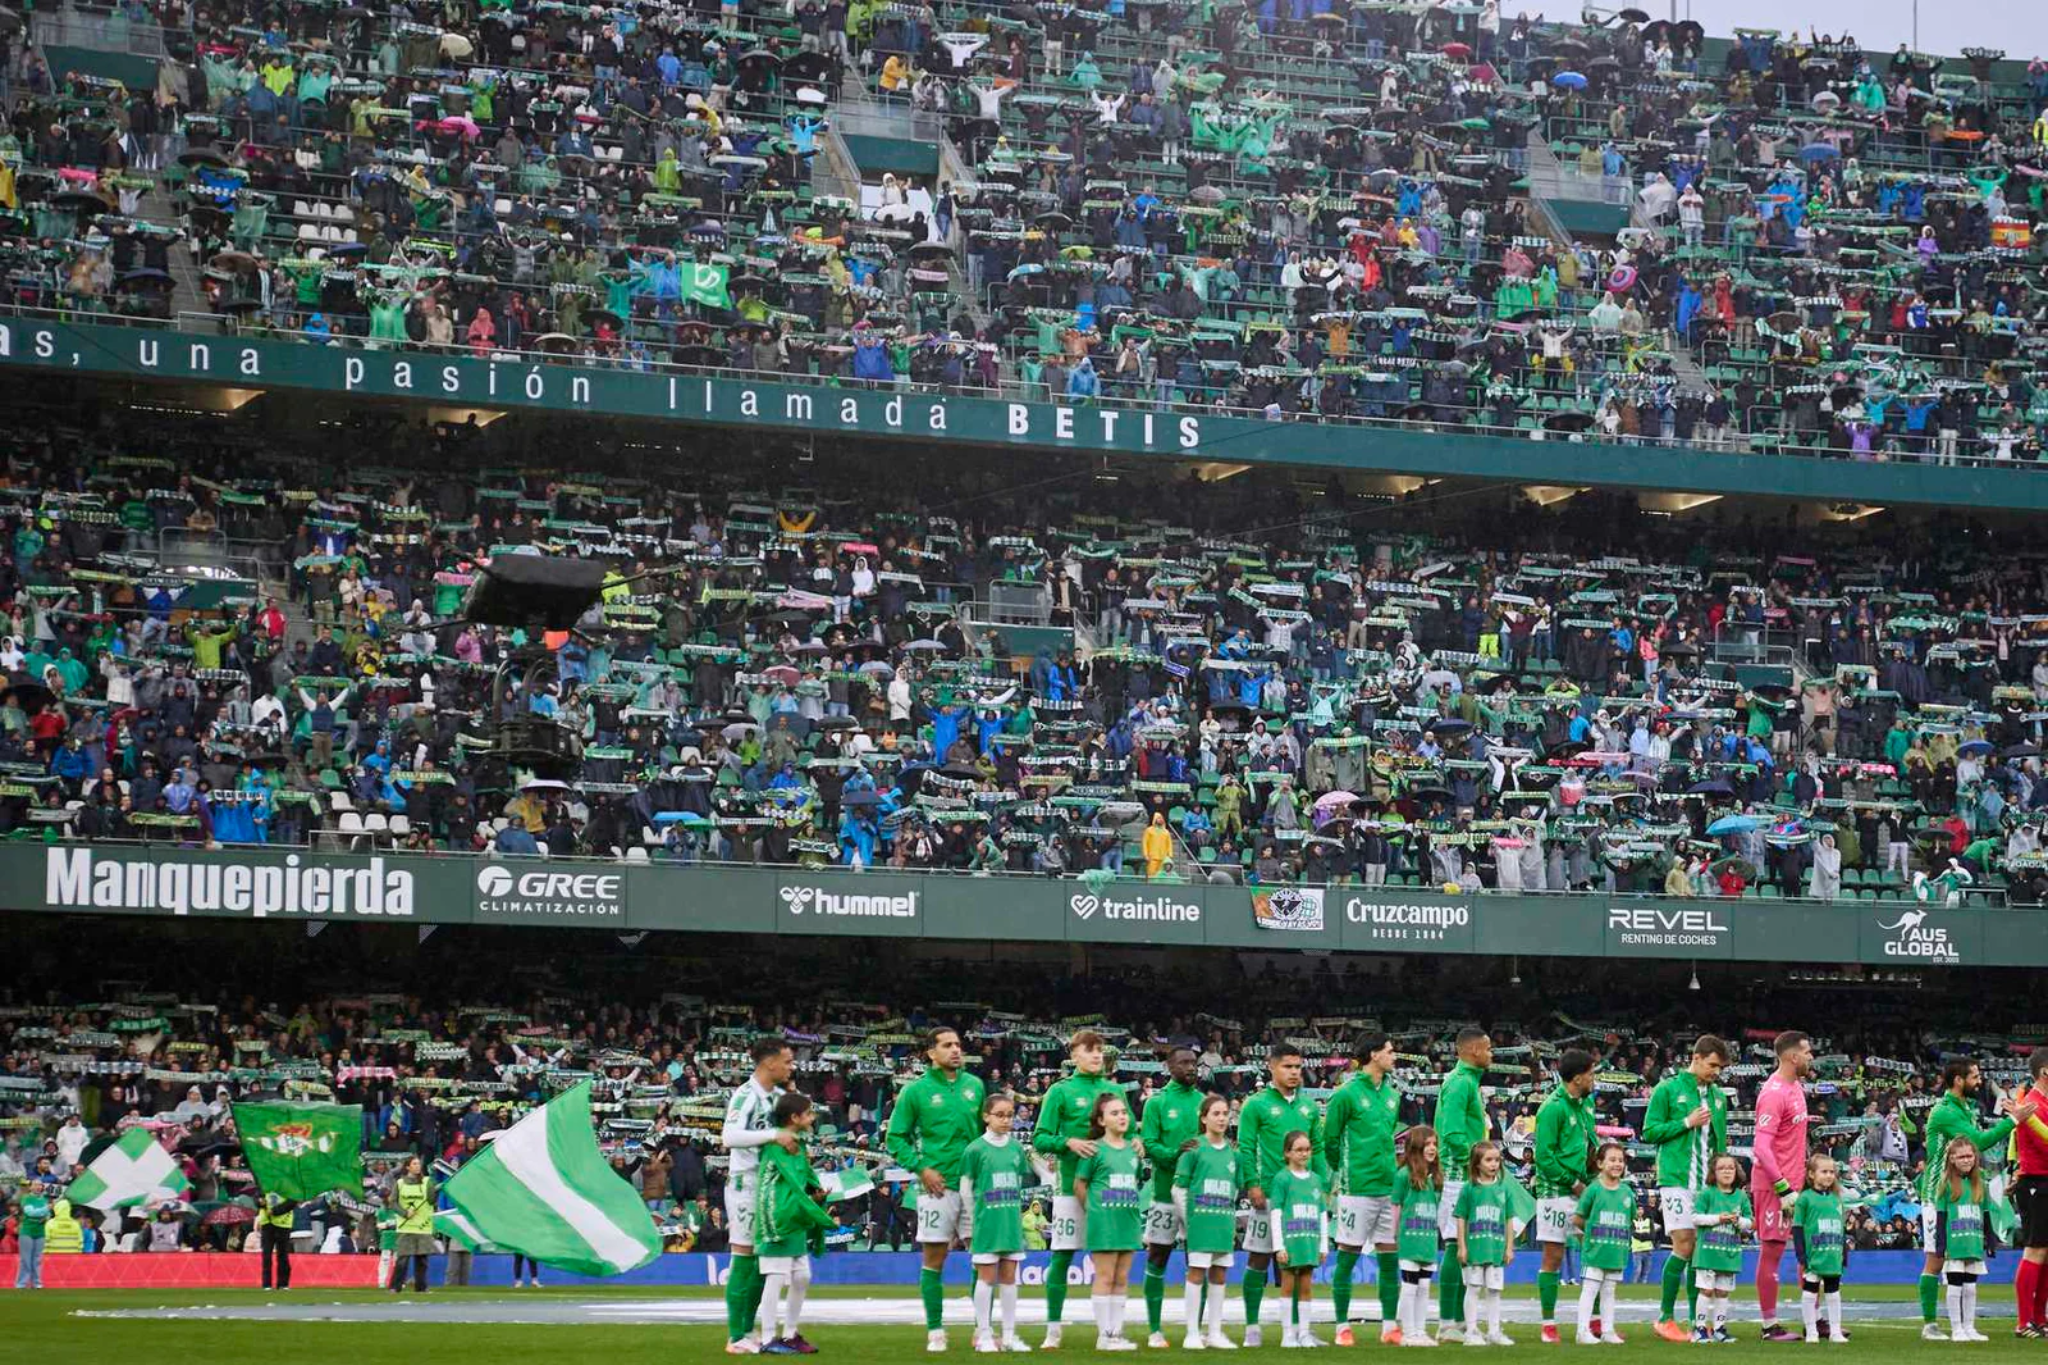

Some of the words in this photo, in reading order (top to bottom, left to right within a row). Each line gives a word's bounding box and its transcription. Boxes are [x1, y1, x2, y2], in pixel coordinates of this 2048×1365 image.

[140, 339, 260, 375] una
[345, 356, 591, 403] pasión
[669, 377, 947, 431] llamada
[1008, 404, 1200, 449] BETIS
[46, 846, 414, 918] Manquepierda
[518, 872, 621, 899] GREE
[479, 900, 619, 915] CLIMATIZACIÓN
[814, 888, 916, 917] hummel
[1102, 896, 1200, 921] trainline
[1346, 896, 1470, 929] Cruzcampo
[1608, 909, 1729, 931] REVEL
[1621, 933, 1663, 944] RENTING
[1664, 934, 1677, 944] DE
[1678, 934, 1717, 945] COCHES
[1908, 927, 1947, 942] AUS
[1884, 941, 1960, 957] GLOBAL
[1674, 1198, 1683, 1215] 3
[748, 1212, 755, 1230] 7
[923, 1209, 940, 1228] 12
[1057, 1217, 1076, 1236] 36
[1151, 1210, 1173, 1230] 23
[1346, 1212, 1356, 1230] 4
[1552, 1210, 1566, 1228] 18
[1251, 1219, 1268, 1240] 19
